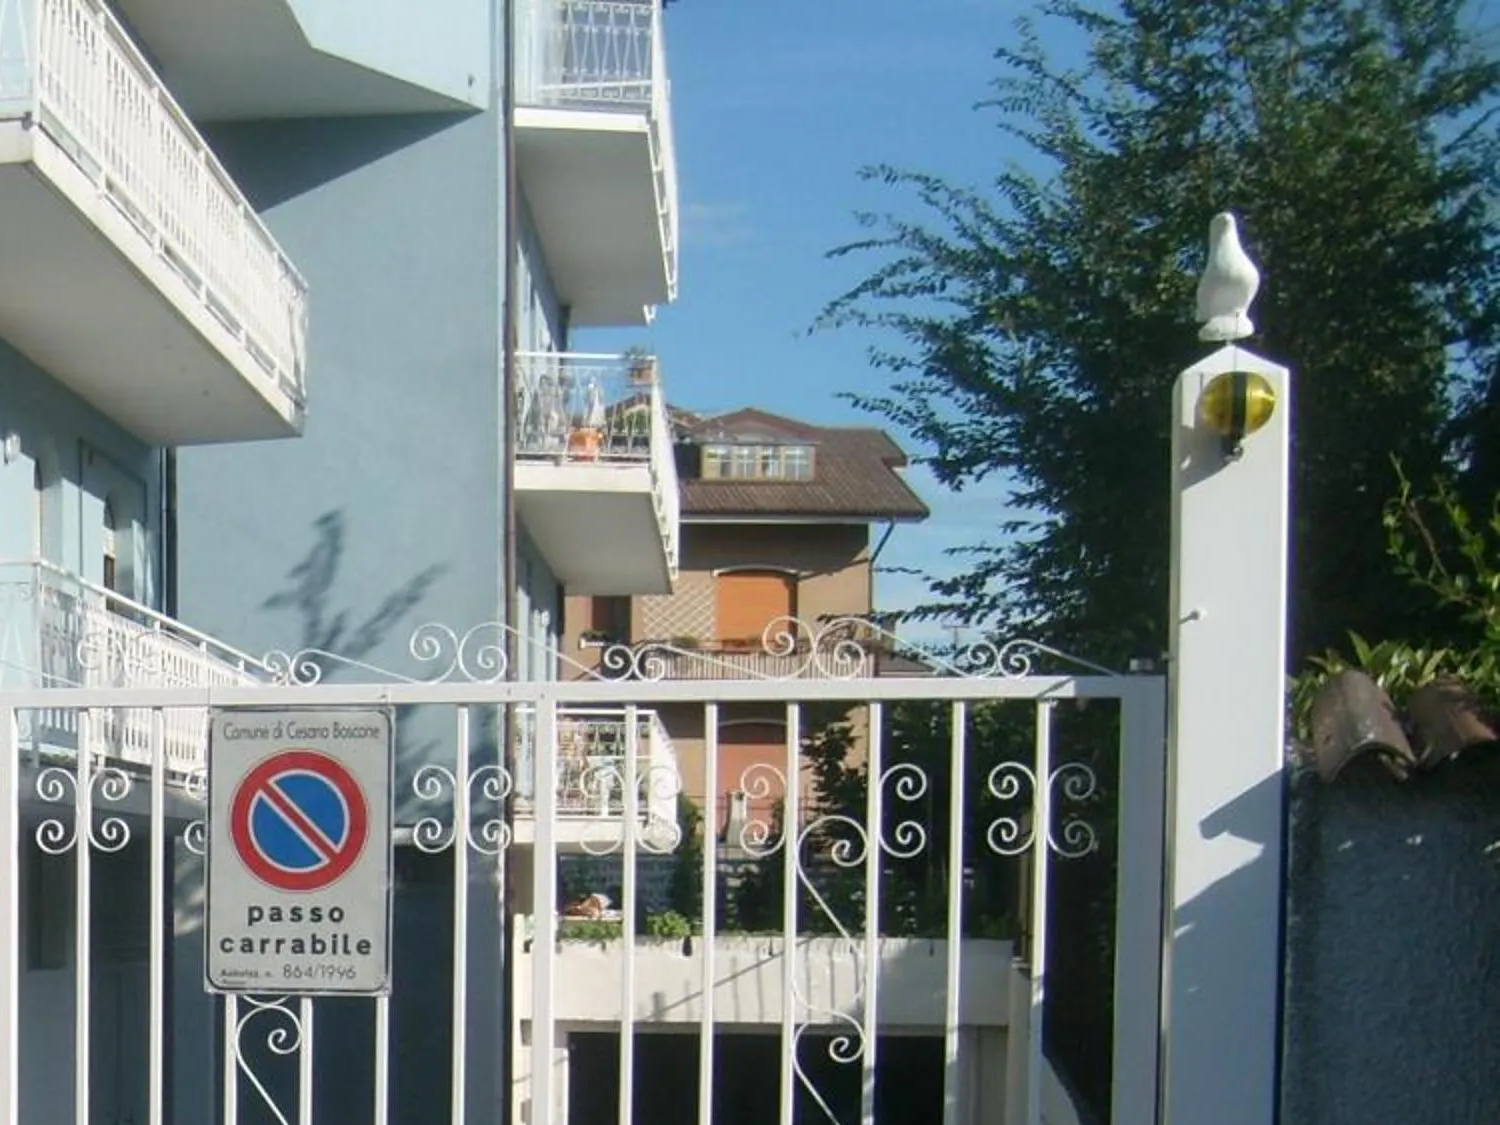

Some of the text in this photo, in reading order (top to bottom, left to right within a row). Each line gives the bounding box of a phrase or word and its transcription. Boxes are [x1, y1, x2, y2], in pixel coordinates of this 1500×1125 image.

[223, 720, 380, 740] Comune di Cesano Boscone
[247, 905, 345, 927] passo
[219, 933, 372, 956] carrabile
